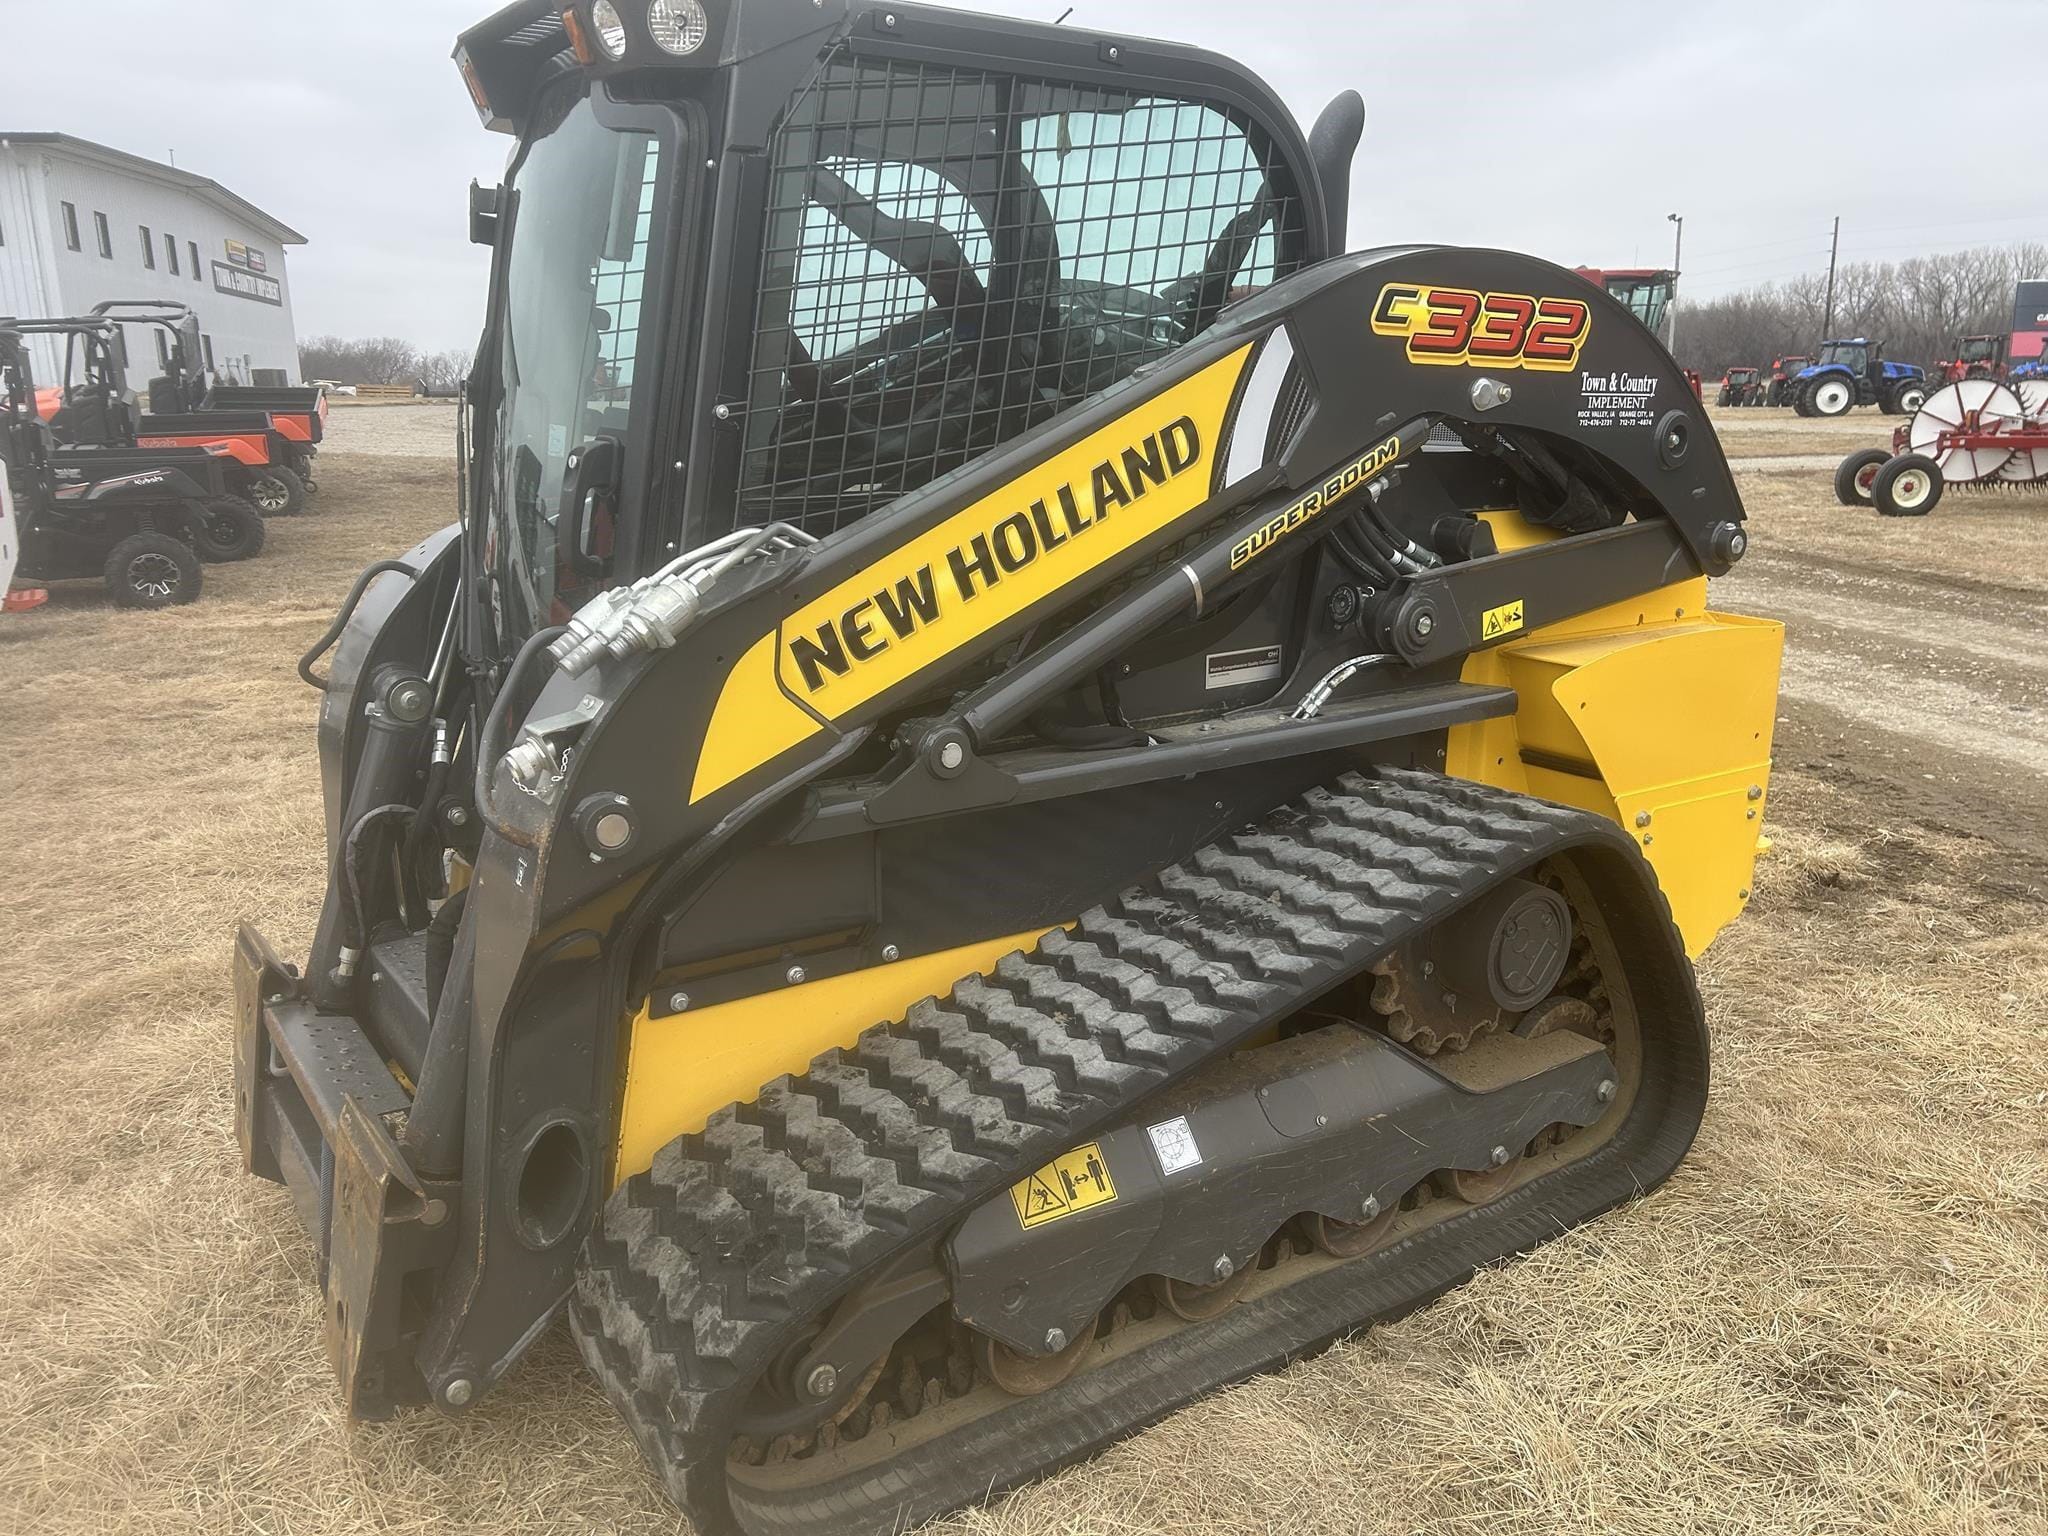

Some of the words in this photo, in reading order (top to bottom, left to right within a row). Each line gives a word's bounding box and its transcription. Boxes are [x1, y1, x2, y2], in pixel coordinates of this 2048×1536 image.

[1374, 284, 1591, 370] C332
[1581, 372, 1607, 391] Town
[1609, 372, 1618, 392] &
[1620, 373, 1658, 397] Country
[1588, 397, 1647, 408] IMPLEMENT
[133, 475, 164, 486] Kubota
[1231, 491, 1321, 570] SUPER
[1324, 436, 1399, 506] BOOM
[788, 562, 941, 694] NEW
[944, 414, 1203, 603] HOLLAND
